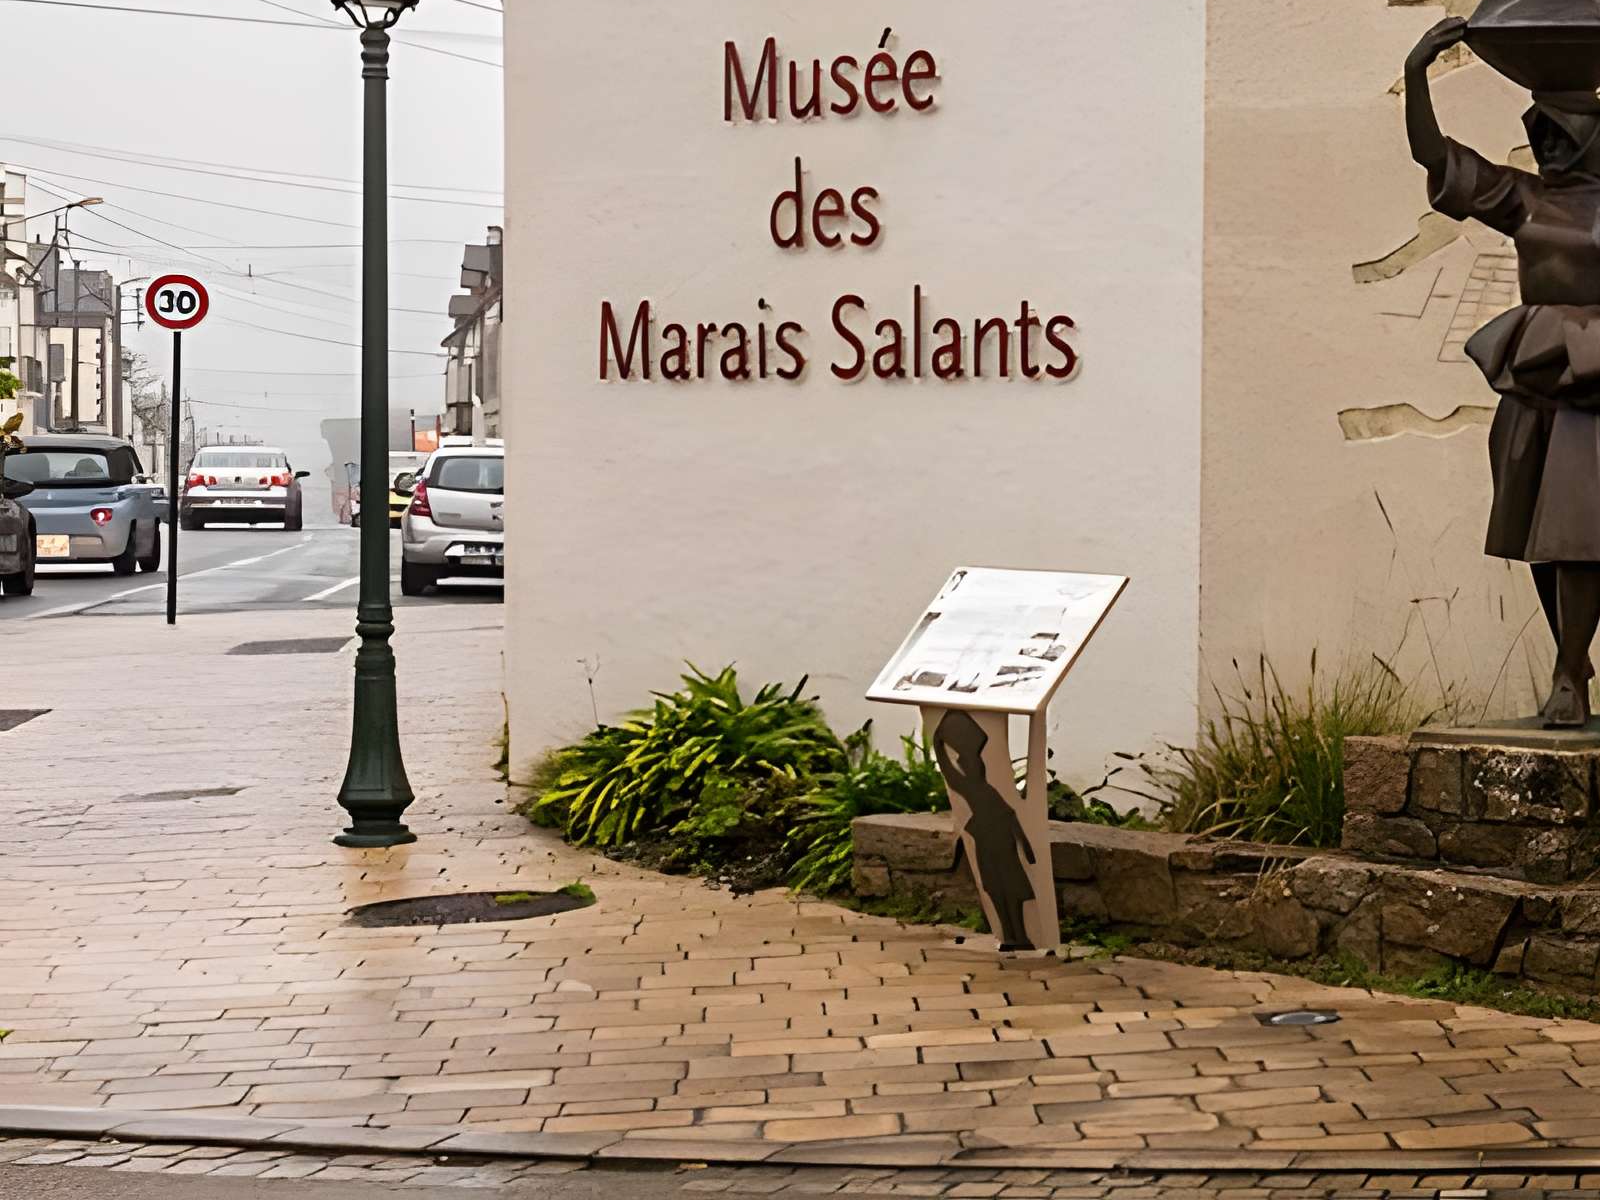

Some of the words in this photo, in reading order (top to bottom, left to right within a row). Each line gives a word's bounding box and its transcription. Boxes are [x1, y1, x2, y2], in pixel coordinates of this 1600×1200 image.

[724, 27, 938, 121] Musée
[769, 156, 882, 249] des
[159, 290, 196, 314] 30
[599, 298, 806, 380] Marais
[830, 284, 1078, 380] Salants
